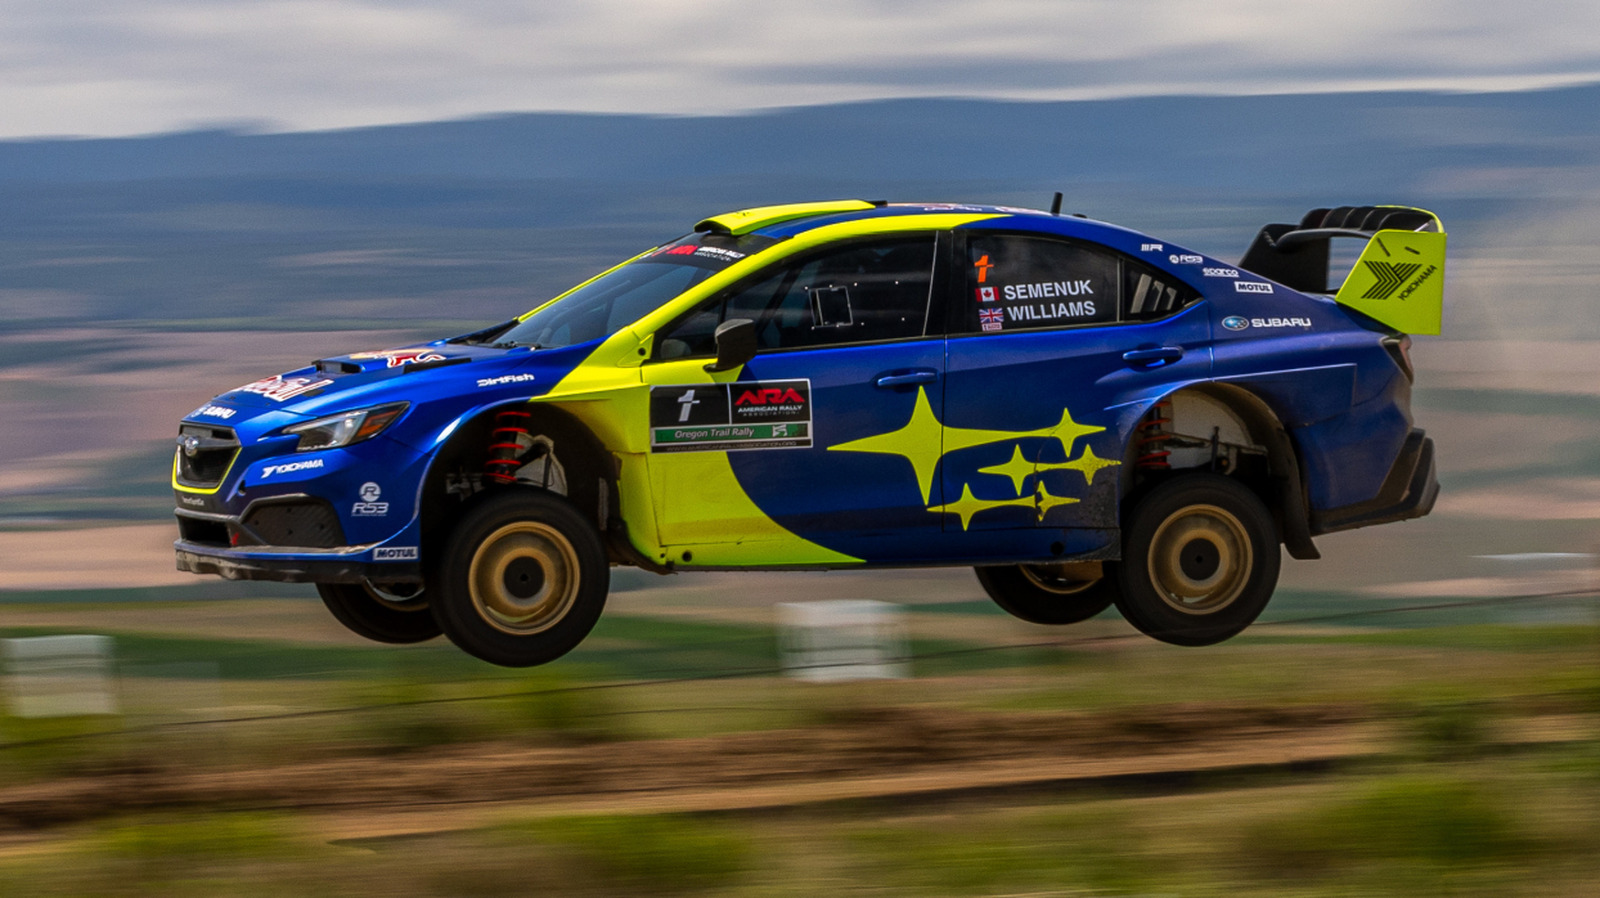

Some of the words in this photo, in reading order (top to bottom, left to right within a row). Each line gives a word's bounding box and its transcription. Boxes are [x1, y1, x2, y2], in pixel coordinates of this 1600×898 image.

[974, 254, 994, 283] 1
[1202, 267, 1240, 278] sparco
[1004, 279, 1094, 301] SEMENUK
[1237, 282, 1271, 293] MOTUL
[1397, 265, 1437, 301] YOKOHAMA
[1007, 300, 1096, 322] WILLIAMS
[1251, 317, 1312, 328] SUBARU
[476, 373, 535, 387] DirtFish
[735, 387, 805, 406] ARA
[677, 389, 700, 422] 1
[738, 405, 778, 413] AMERICAN
[779, 404, 803, 412] RALLY
[674, 430, 708, 440] Oregon
[711, 427, 730, 438] Trail
[732, 426, 755, 438] Rally
[376, 548, 415, 558] MOTUL
